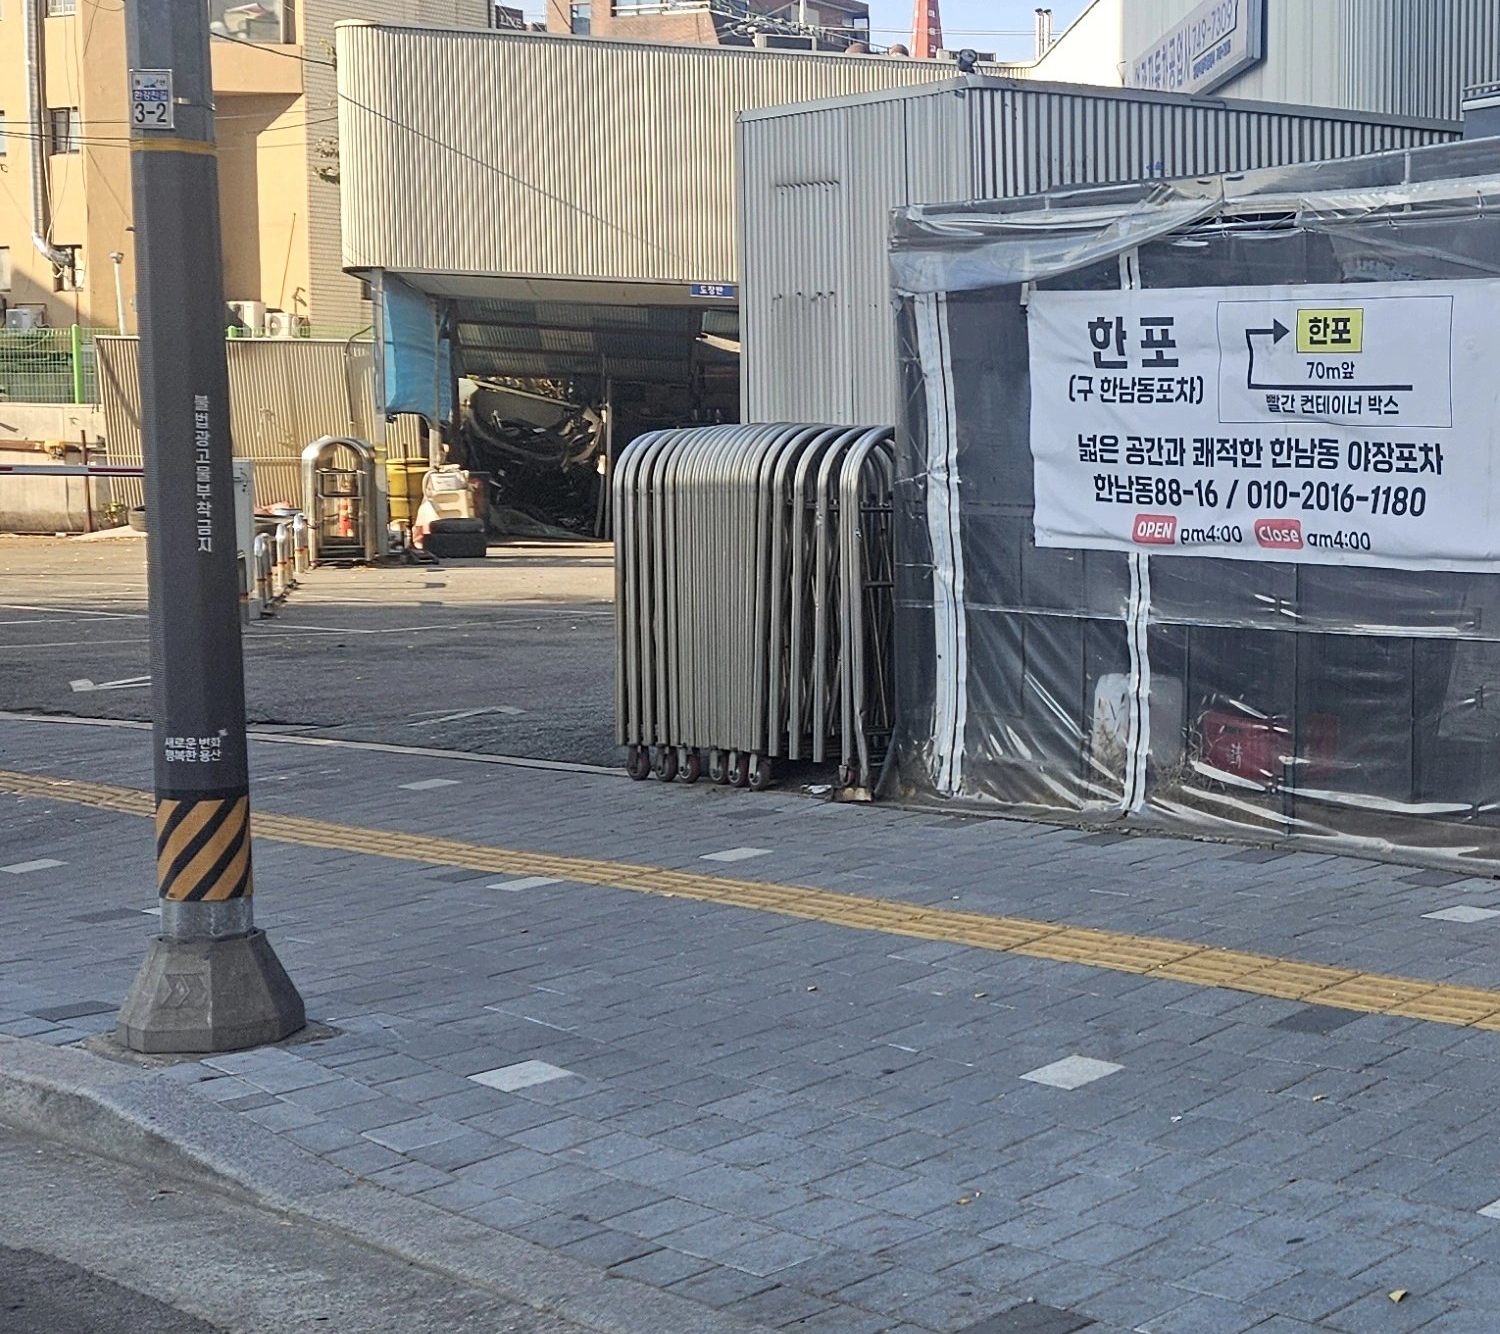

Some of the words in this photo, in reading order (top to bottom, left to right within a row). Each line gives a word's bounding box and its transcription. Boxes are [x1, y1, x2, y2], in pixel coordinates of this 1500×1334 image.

[135, 102, 167, 123] 3-2
[1308, 317, 1352, 345] 한포
[1306, 361, 1355, 380] 70m앞
[1069, 374, 1094, 402] (구
[1100, 375, 1204, 404] 한남동포차)
[1266, 394, 1296, 414] 빨간
[1300, 395, 1362, 415] 컨테이너
[1367, 394, 1400, 416] 박스
[1078, 434, 1119, 464] 넓은
[1126, 436, 1186, 467] 공간과
[1192, 437, 1263, 469] 쾌적한
[1270, 438, 1340, 470] 한남동
[1348, 441, 1444, 476] 야장포차
[194, 394, 212, 553] 불법광고물부착금지
[1093, 473, 1219, 508] 한남동88-16
[1247, 480, 1426, 517] 010-2016-1180
[1137, 521, 1173, 539] OPEN
[1180, 524, 1243, 545] pm4:00
[1258, 526, 1300, 543] Close
[1307, 531, 1372, 551] am4:00
[165, 737, 197, 750] 새로운
[199, 737, 222, 750] 변화
[165, 749, 198, 762] 행복한
[199, 749, 222, 763] 용산
